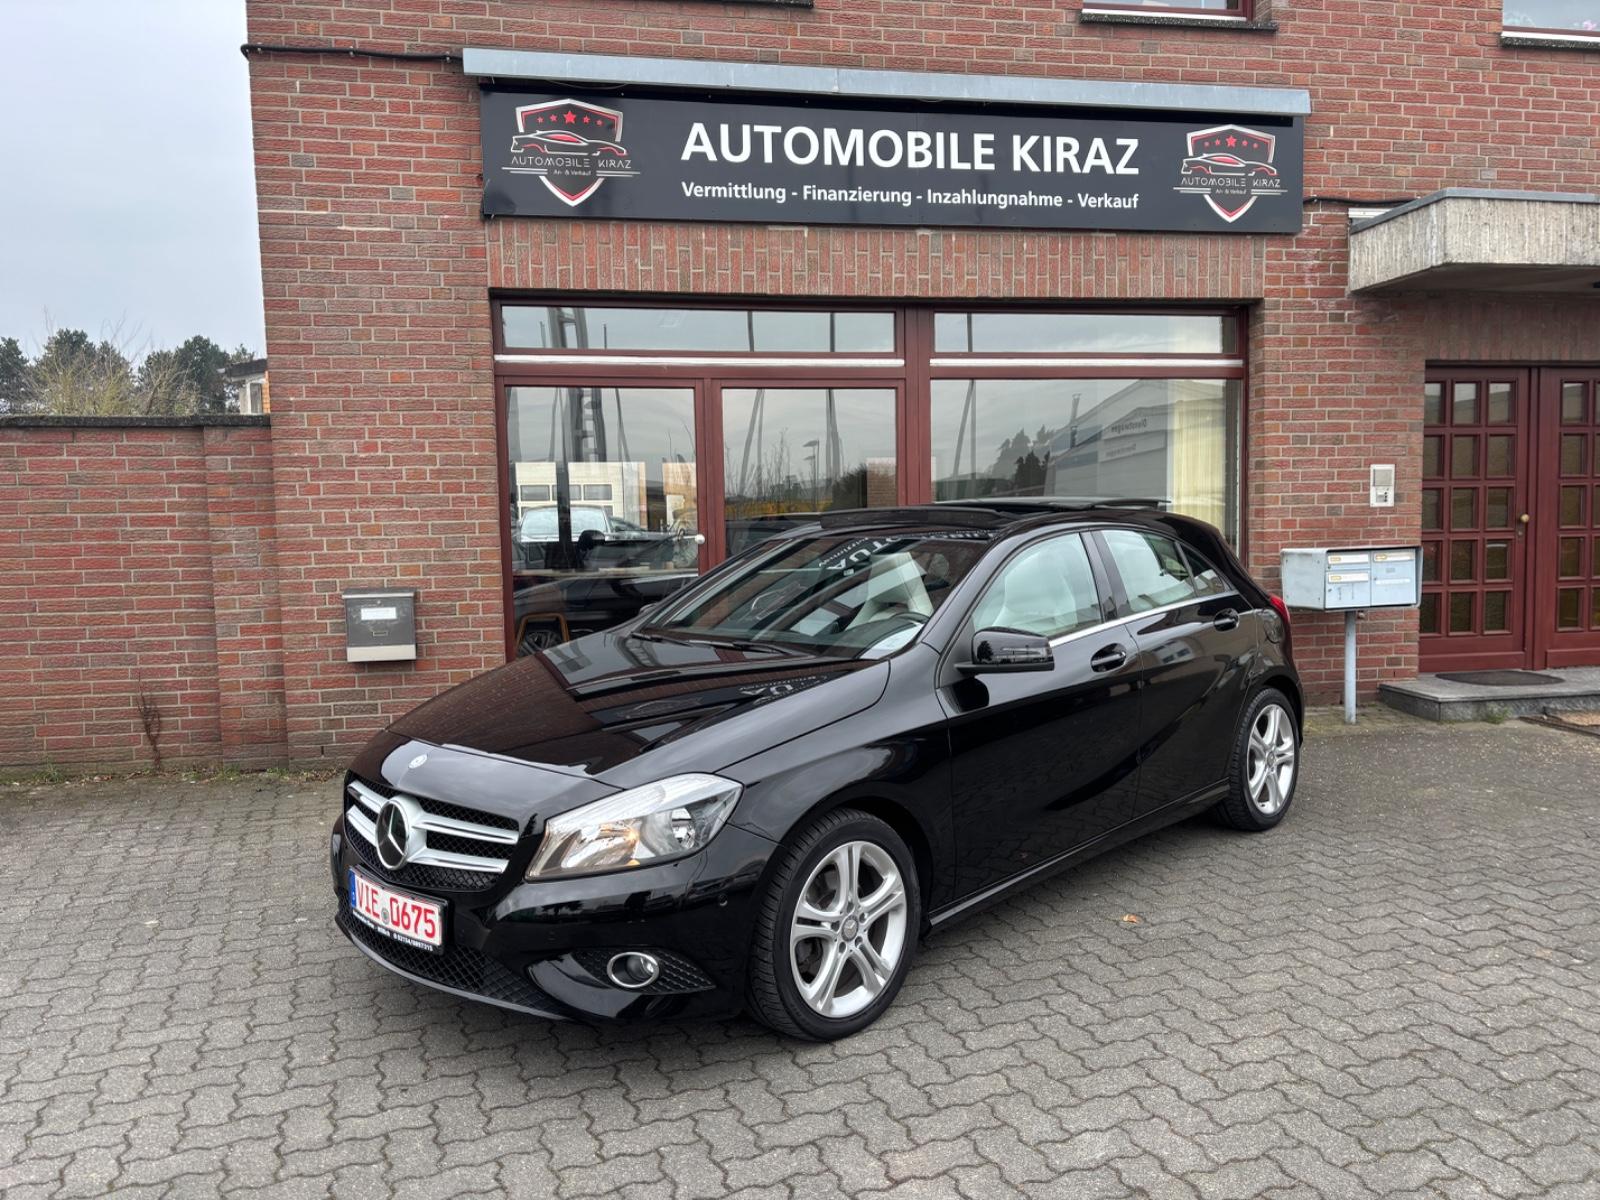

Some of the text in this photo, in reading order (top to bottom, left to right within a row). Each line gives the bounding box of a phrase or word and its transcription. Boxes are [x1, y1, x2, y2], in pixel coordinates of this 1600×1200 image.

[510, 155, 632, 169] AUTOMOBILE KIRAZ
[681, 122, 1140, 175] AUTOMOBILE KIRAZ
[681, 181, 787, 204] Vermittlung
[802, 184, 912, 208] Finanzierung
[927, 188, 1063, 210] Inzahlungnahme
[1077, 192, 1140, 209] Verkauf
[1180, 176, 1281, 188] AUTOMOBILE KIRAZ
[356, 879, 380, 919] VIE
[389, 896, 436, 939] 0675
